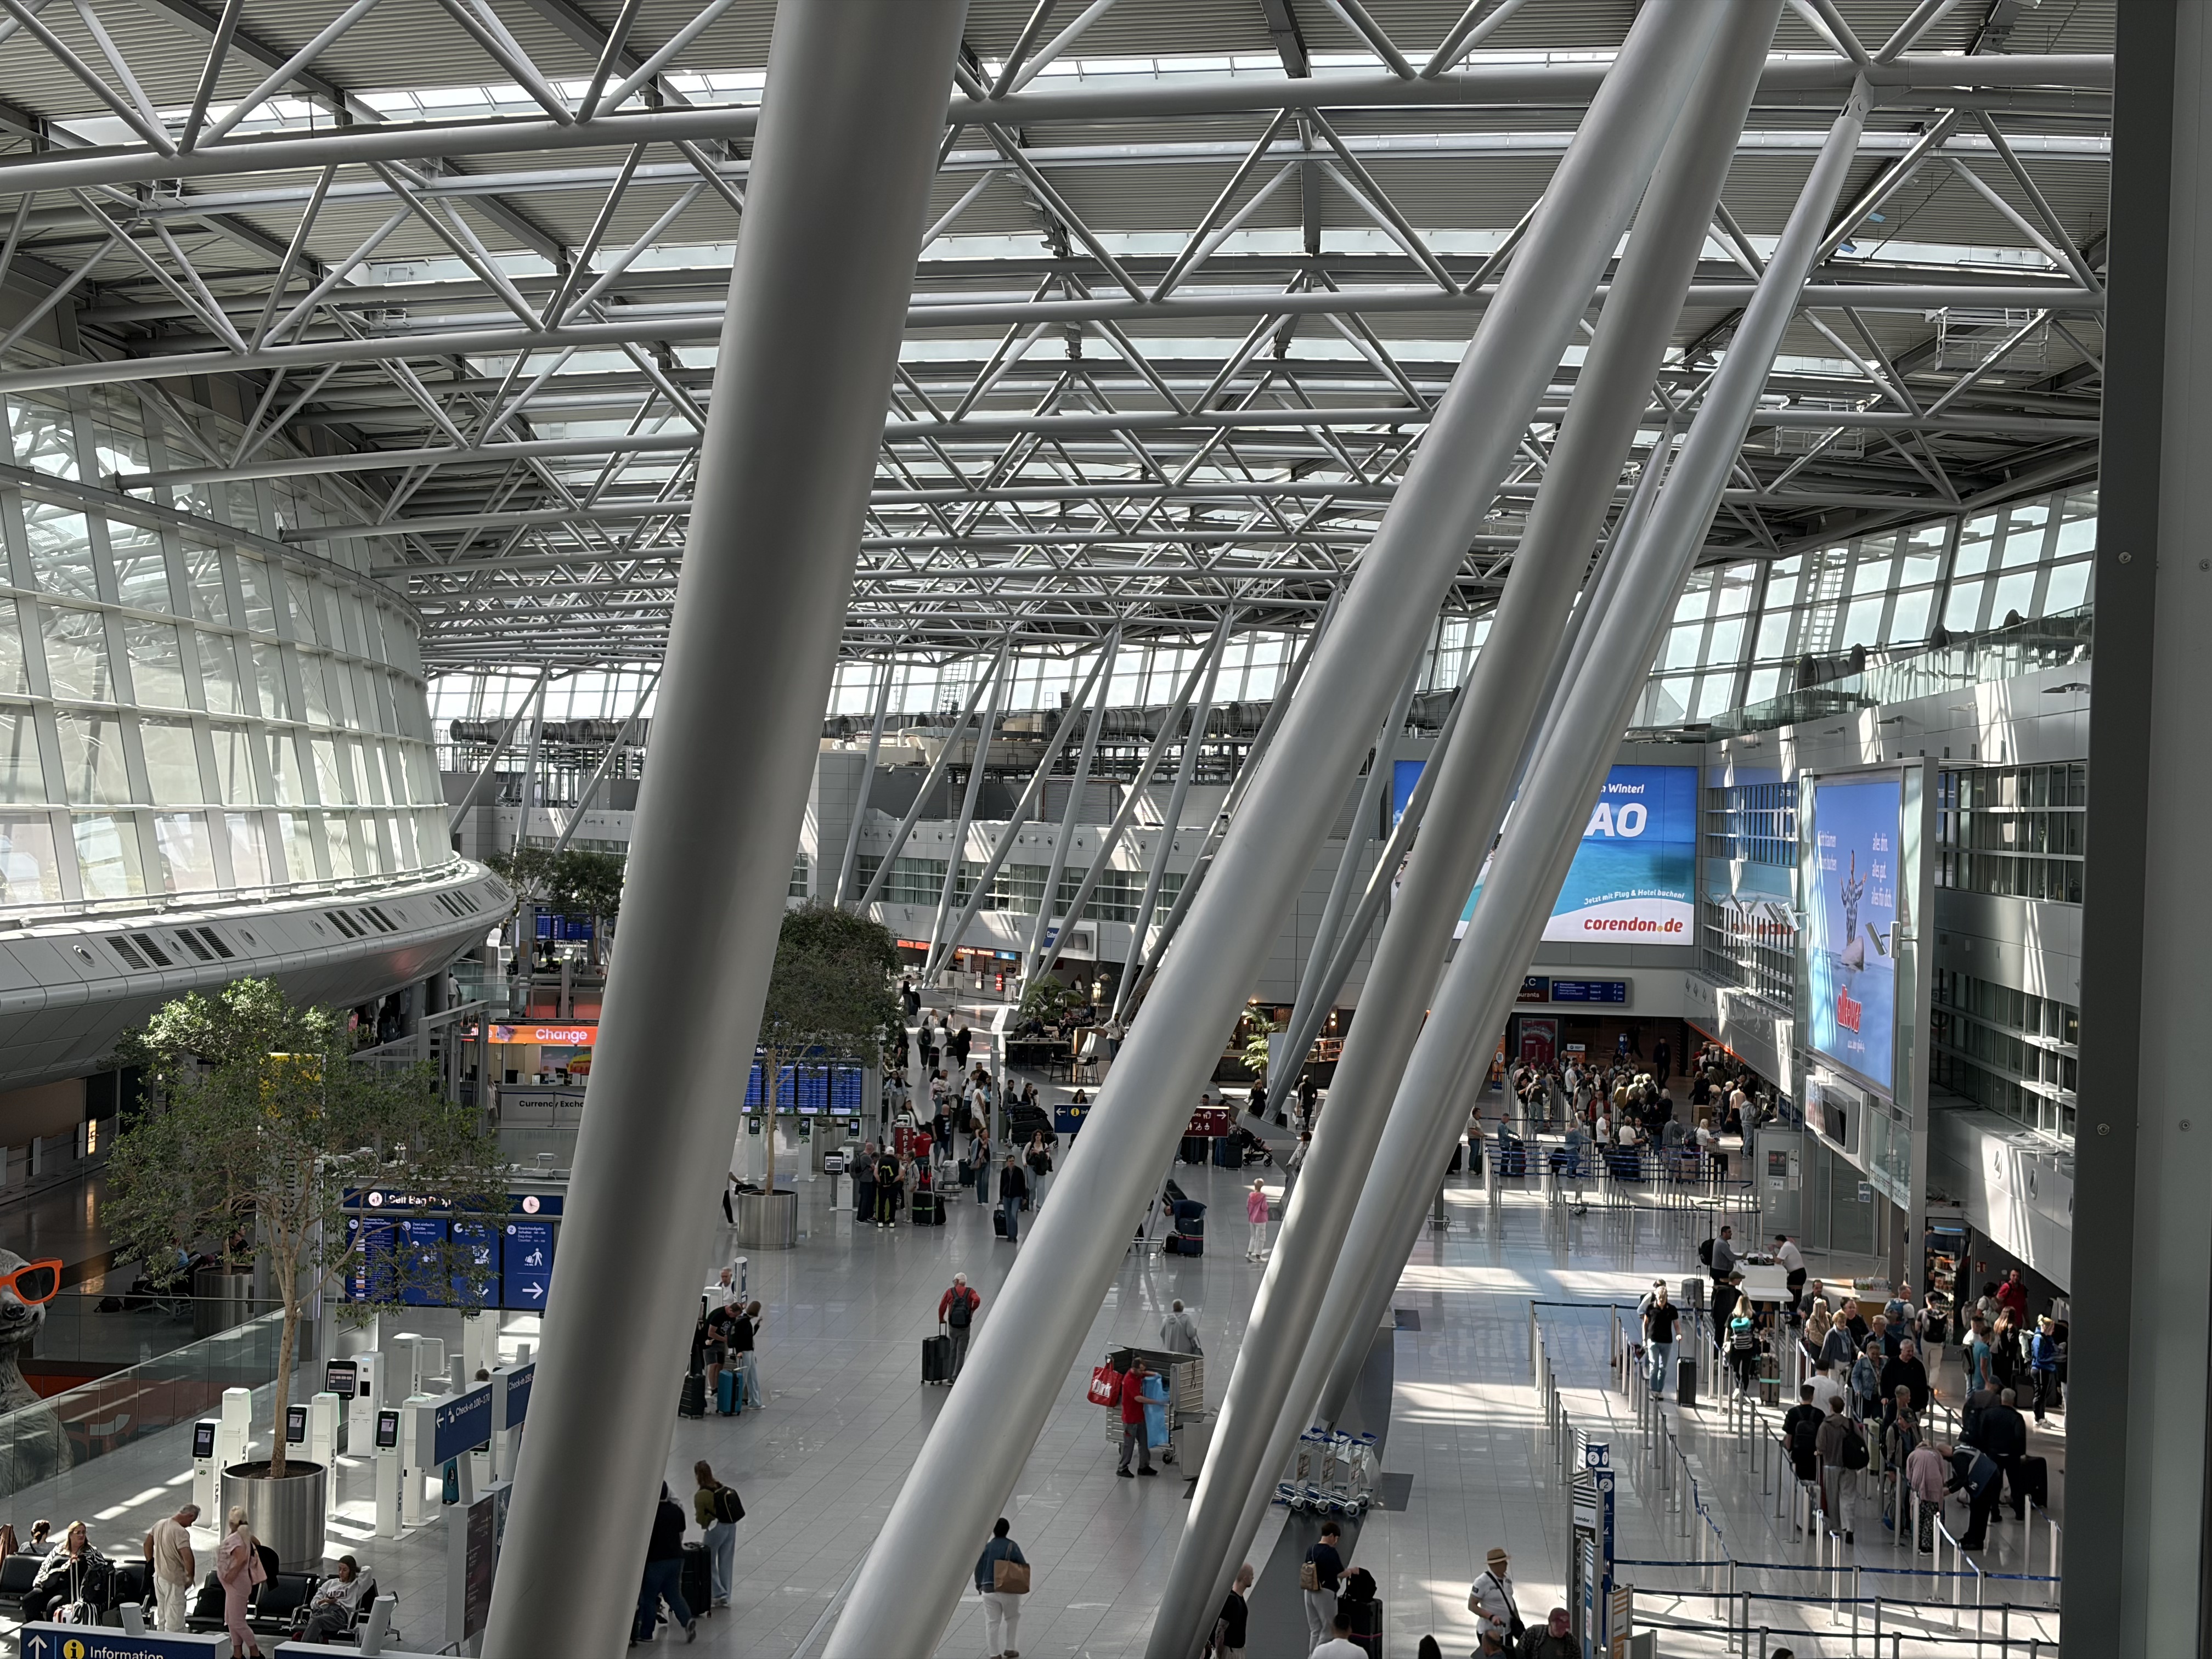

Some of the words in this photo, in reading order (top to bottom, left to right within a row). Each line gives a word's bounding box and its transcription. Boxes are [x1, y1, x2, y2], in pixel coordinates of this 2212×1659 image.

[1609, 783, 1645, 793] Winter!
[1584, 896, 1601, 905] Jetzt
[1657, 889, 1685, 899] buchen!
[1584, 917, 1683, 933] corendon.de
[535, 1029, 588, 1043] Change
[508, 1378, 524, 1391] Check-in
[455, 1401, 474, 1416] Check-in
[91, 1646, 163, 1659] Information
